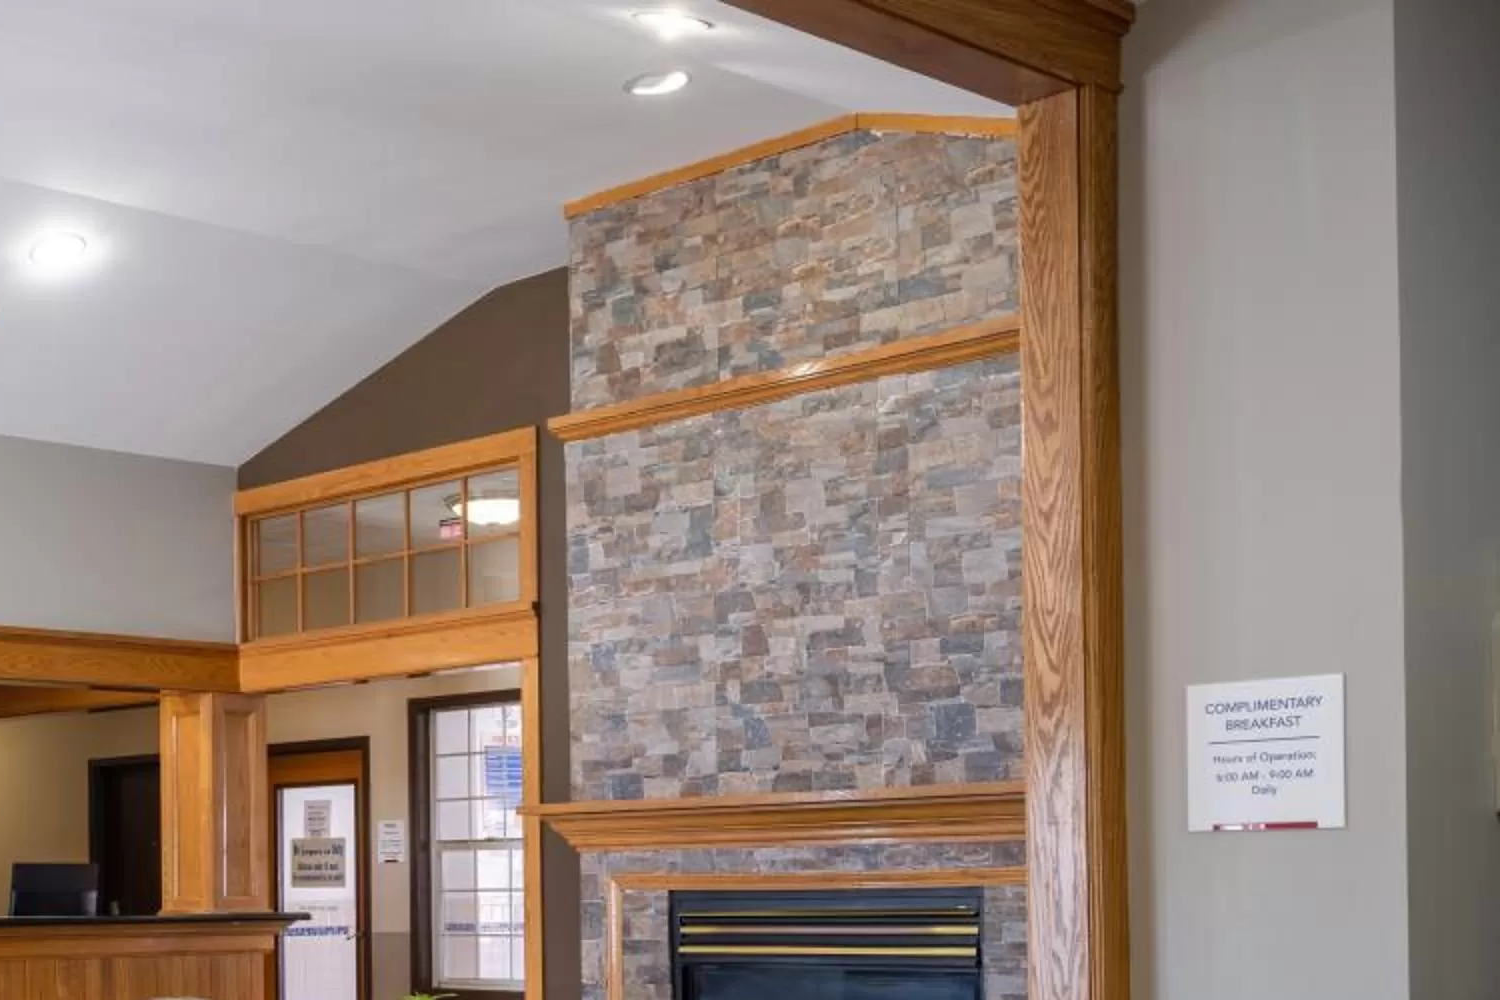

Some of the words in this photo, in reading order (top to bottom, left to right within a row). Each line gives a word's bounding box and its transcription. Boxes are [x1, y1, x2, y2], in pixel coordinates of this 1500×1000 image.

[1204, 695, 1323, 716] COMPLIMENTARY
[1225, 715, 1302, 731] BREAKFAST
[1213, 754, 1243, 765] Hours
[1246, 751, 1257, 763] of
[1241, 770, 1259, 781] AM
[1295, 768, 1314, 779] AM
[1251, 785, 1278, 797] Daily
